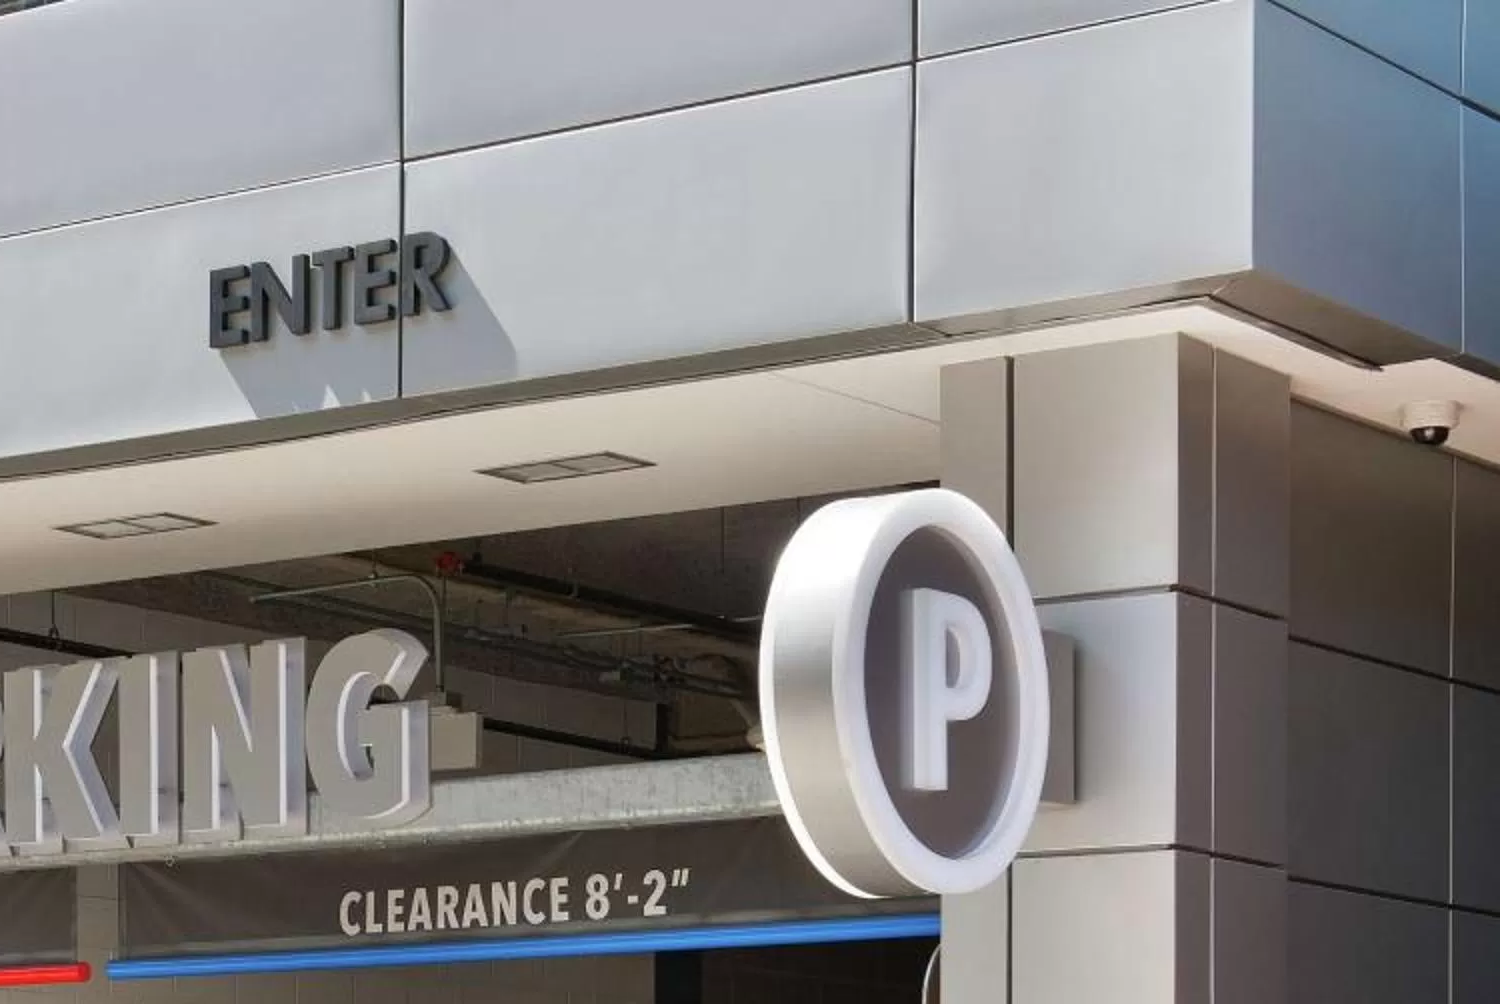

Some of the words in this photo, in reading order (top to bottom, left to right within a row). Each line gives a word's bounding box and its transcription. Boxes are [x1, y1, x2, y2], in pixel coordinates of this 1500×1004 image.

[209, 231, 453, 348] ENTER
[905, 587, 992, 791] P
[339, 876, 569, 937] CLEARANCE
